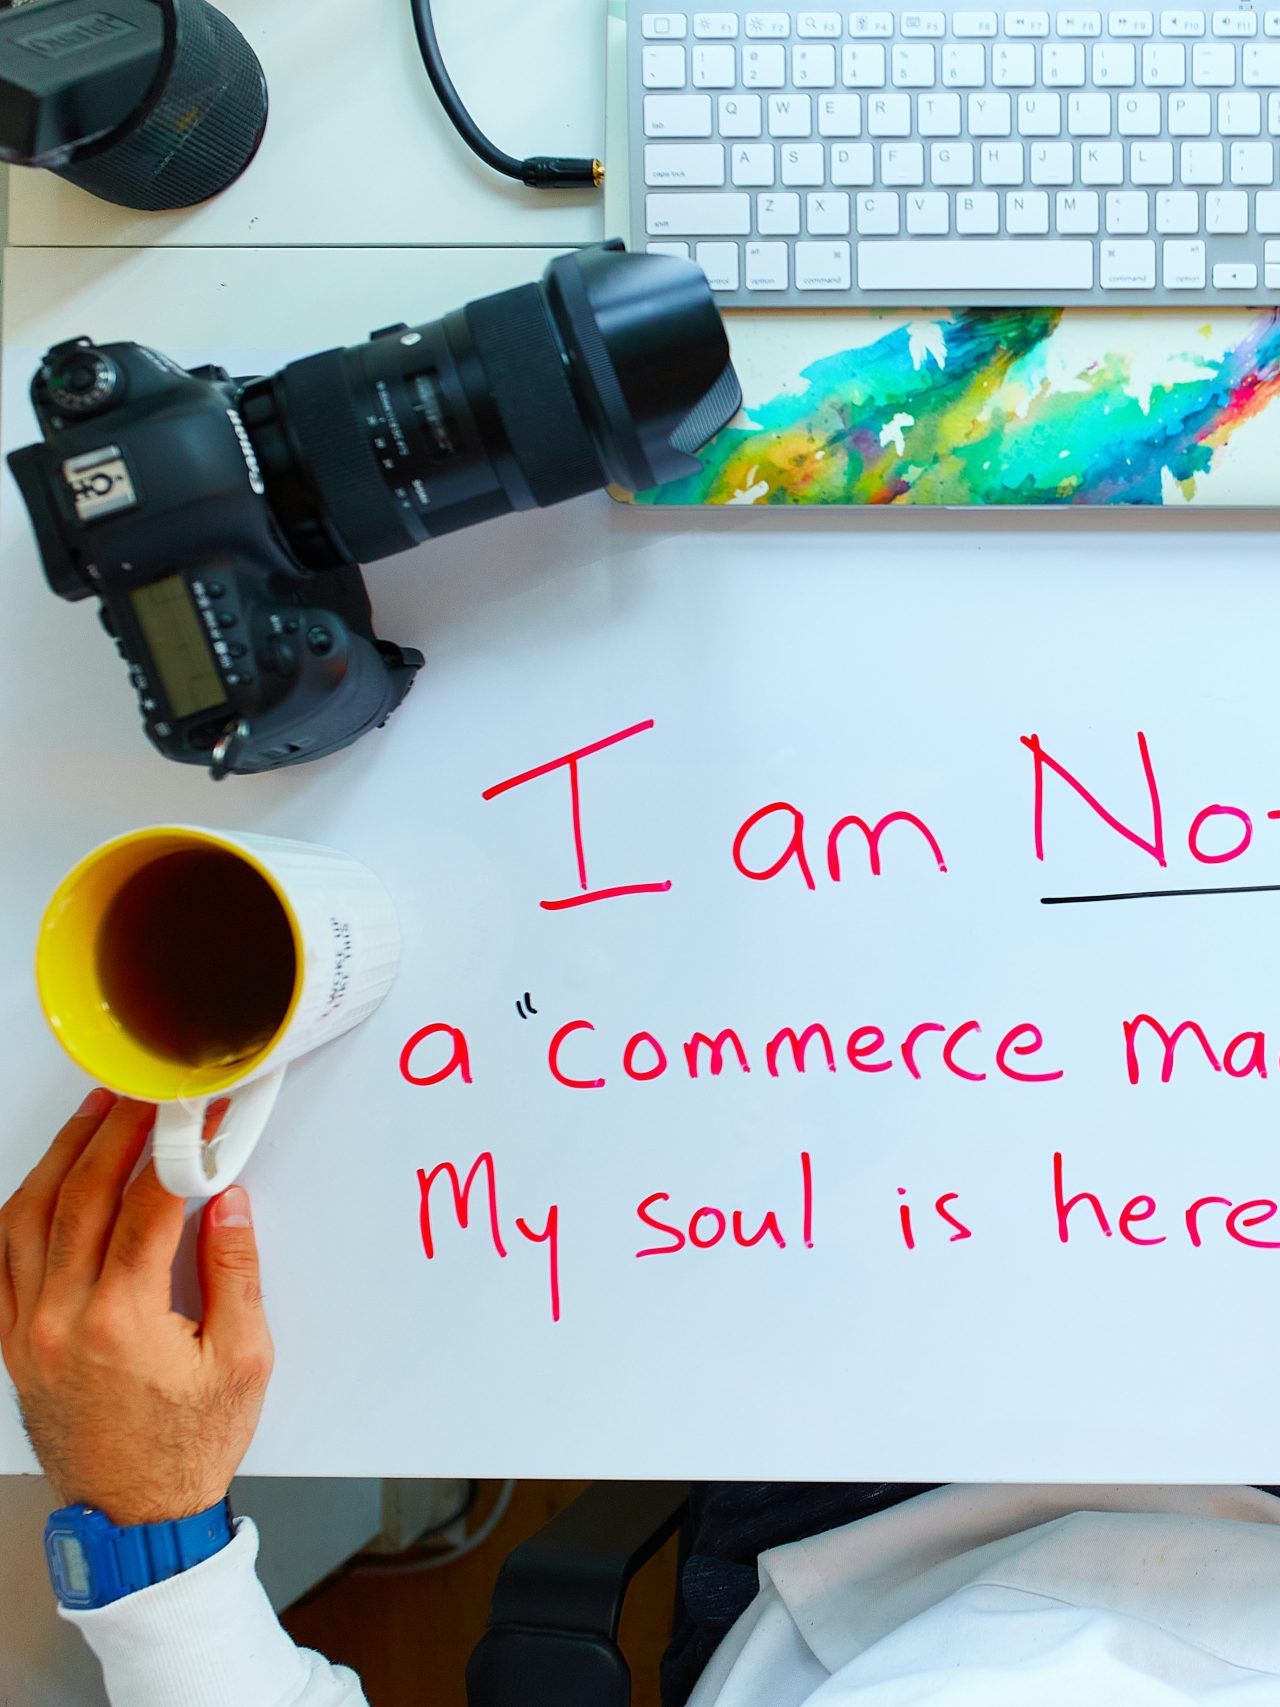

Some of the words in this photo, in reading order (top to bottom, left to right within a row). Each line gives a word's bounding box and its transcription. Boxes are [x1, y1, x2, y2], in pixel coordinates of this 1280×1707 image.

[726, 102, 737, 114] Q
[776, 102, 789, 113] W
[826, 102, 834, 113] E
[876, 101, 885, 112] R
[927, 101, 934, 112] T
[977, 101, 985, 112] Y
[1026, 101, 1035, 112] U
[1127, 100, 1137, 112] O
[1177, 100, 1185, 112] P
[740, 152, 749, 162] A
[789, 151, 798, 163] S
[839, 151, 848, 162] D
[889, 150, 896, 161] F
[939, 150, 950, 162] G
[990, 151, 999, 163] H
[1039, 150, 1046, 161] J
[1089, 151, 1097, 161] K
[1139, 150, 1146, 161] L
[766, 200, 774, 211] Z
[816, 200, 824, 211] X
[865, 199, 874, 211] C
[915, 200, 924, 210] V
[965, 199, 973, 210] B
[1014, 198, 1023, 209] N
[1065, 198, 1075, 209] M
[482, 720, 672, 910] I
[732, 802, 947, 890] am
[400, 1023, 473, 1086] a
[416, 1152, 560, 1322] My
[636, 1152, 814, 1258] soul
[897, 1187, 972, 1249] is
